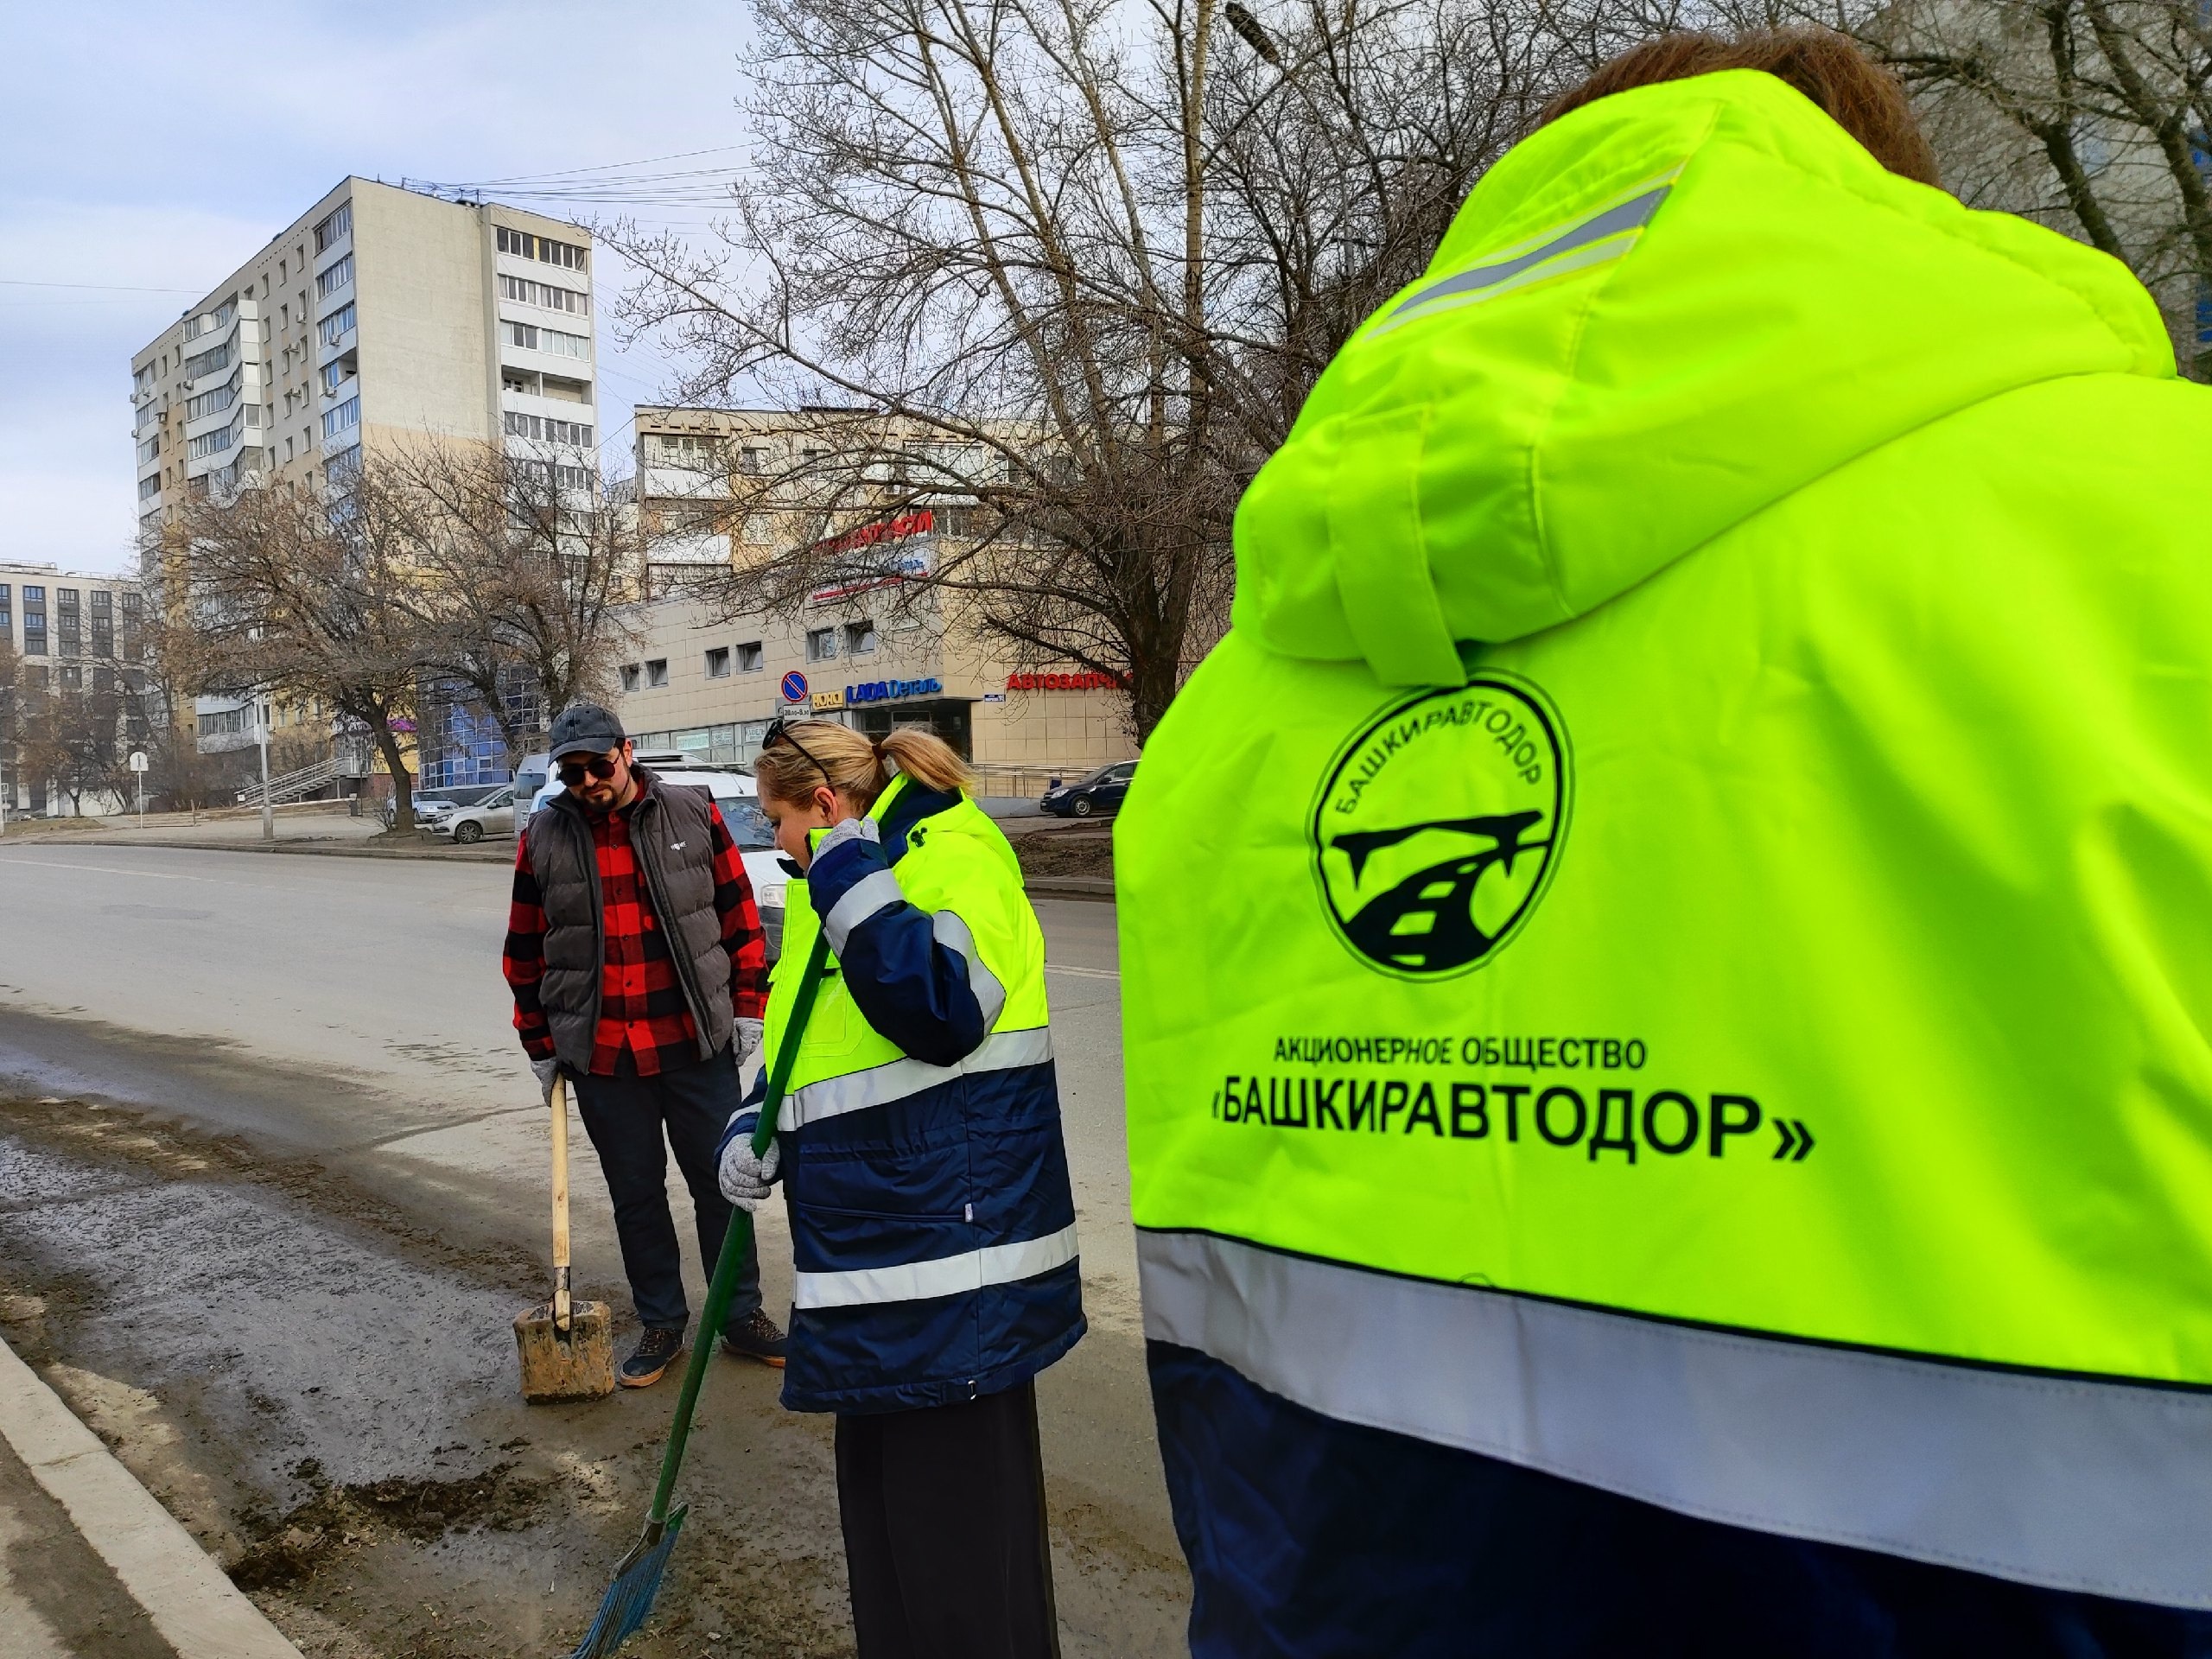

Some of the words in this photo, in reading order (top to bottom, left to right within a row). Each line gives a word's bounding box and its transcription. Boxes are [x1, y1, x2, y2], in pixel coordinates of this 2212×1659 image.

[846, 681, 889, 703] LADA
[1335, 700, 1541, 815] БАШКИРАВТОДОР
[1274, 1037, 1454, 1067] АКЦИОНЕРНОЕ
[1462, 1038, 1648, 1072] ОБЩЕСТВО
[1212, 1076, 1815, 1165] «БАШКИРАВТОДОР»
